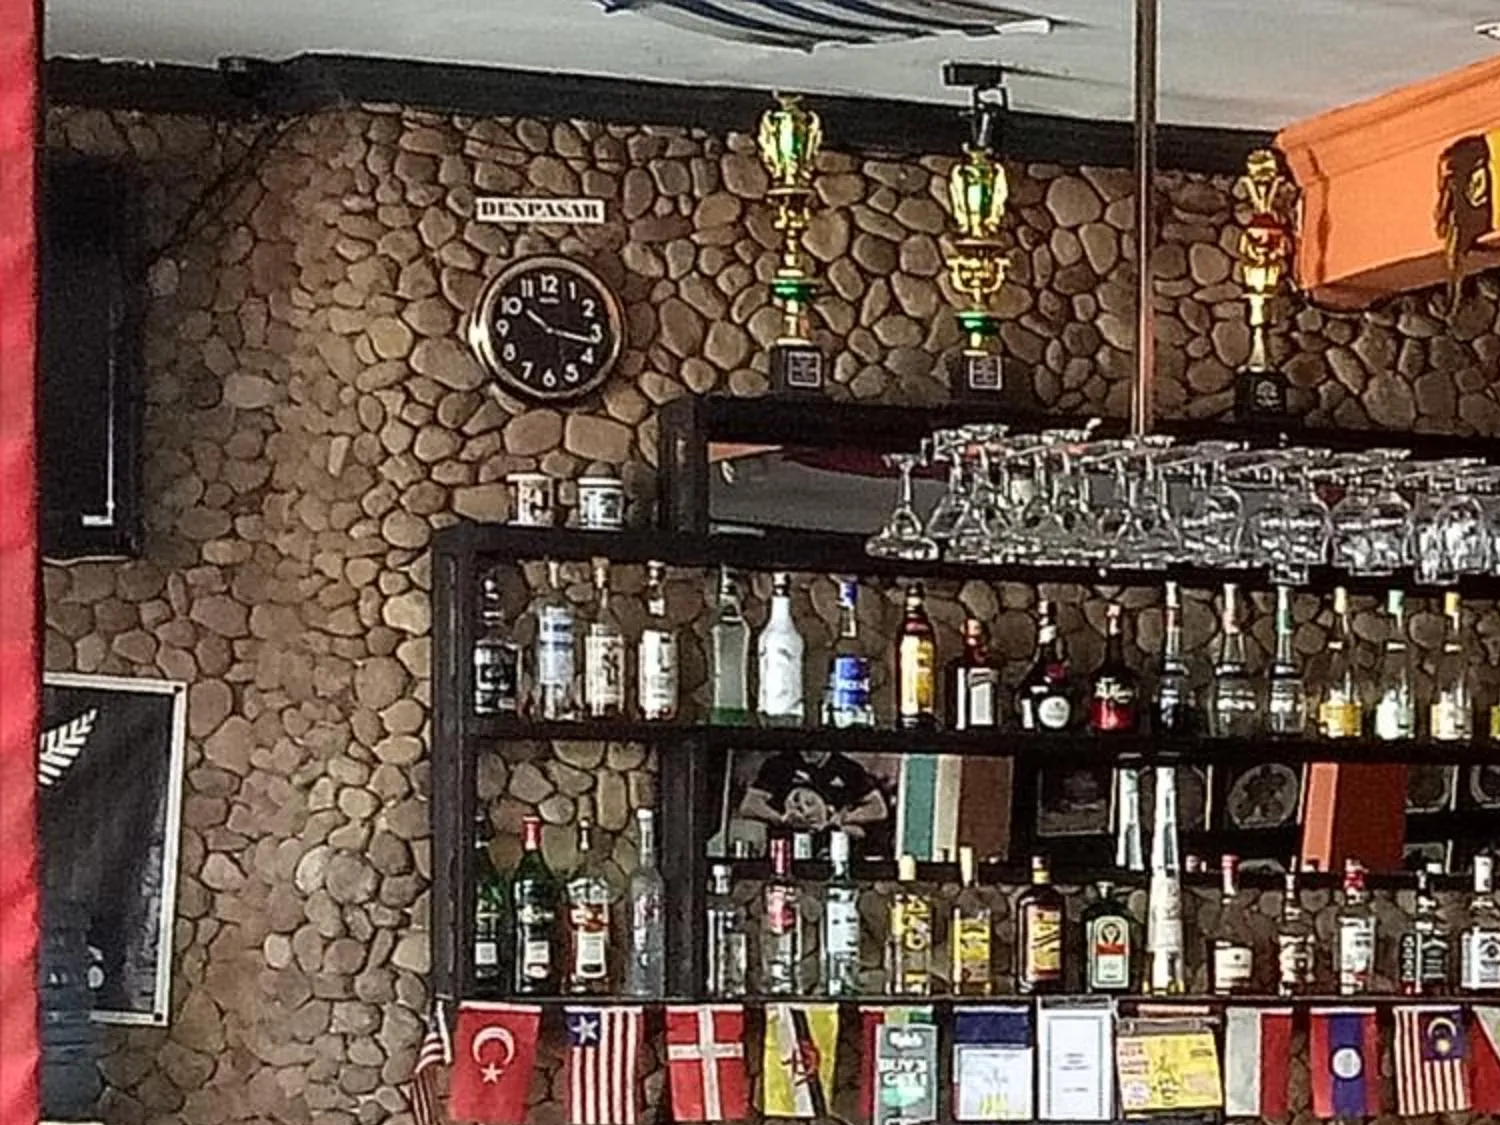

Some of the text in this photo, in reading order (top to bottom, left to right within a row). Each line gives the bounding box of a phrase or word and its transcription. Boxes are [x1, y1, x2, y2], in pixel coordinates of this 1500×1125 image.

[481, 201, 599, 218] DENPASAR
[520, 279, 534, 298] 11
[540, 275, 559, 294] 12
[569, 281, 576, 300] 1
[501, 296, 523, 315] 10
[581, 299, 595, 318] 2
[496, 319, 510, 337] 9
[590, 323, 603, 342] 3
[503, 343, 516, 361] 8
[580, 347, 594, 365] 4
[521, 361, 534, 379] 7
[543, 369, 557, 387] 6
[564, 363, 579, 382] 5
